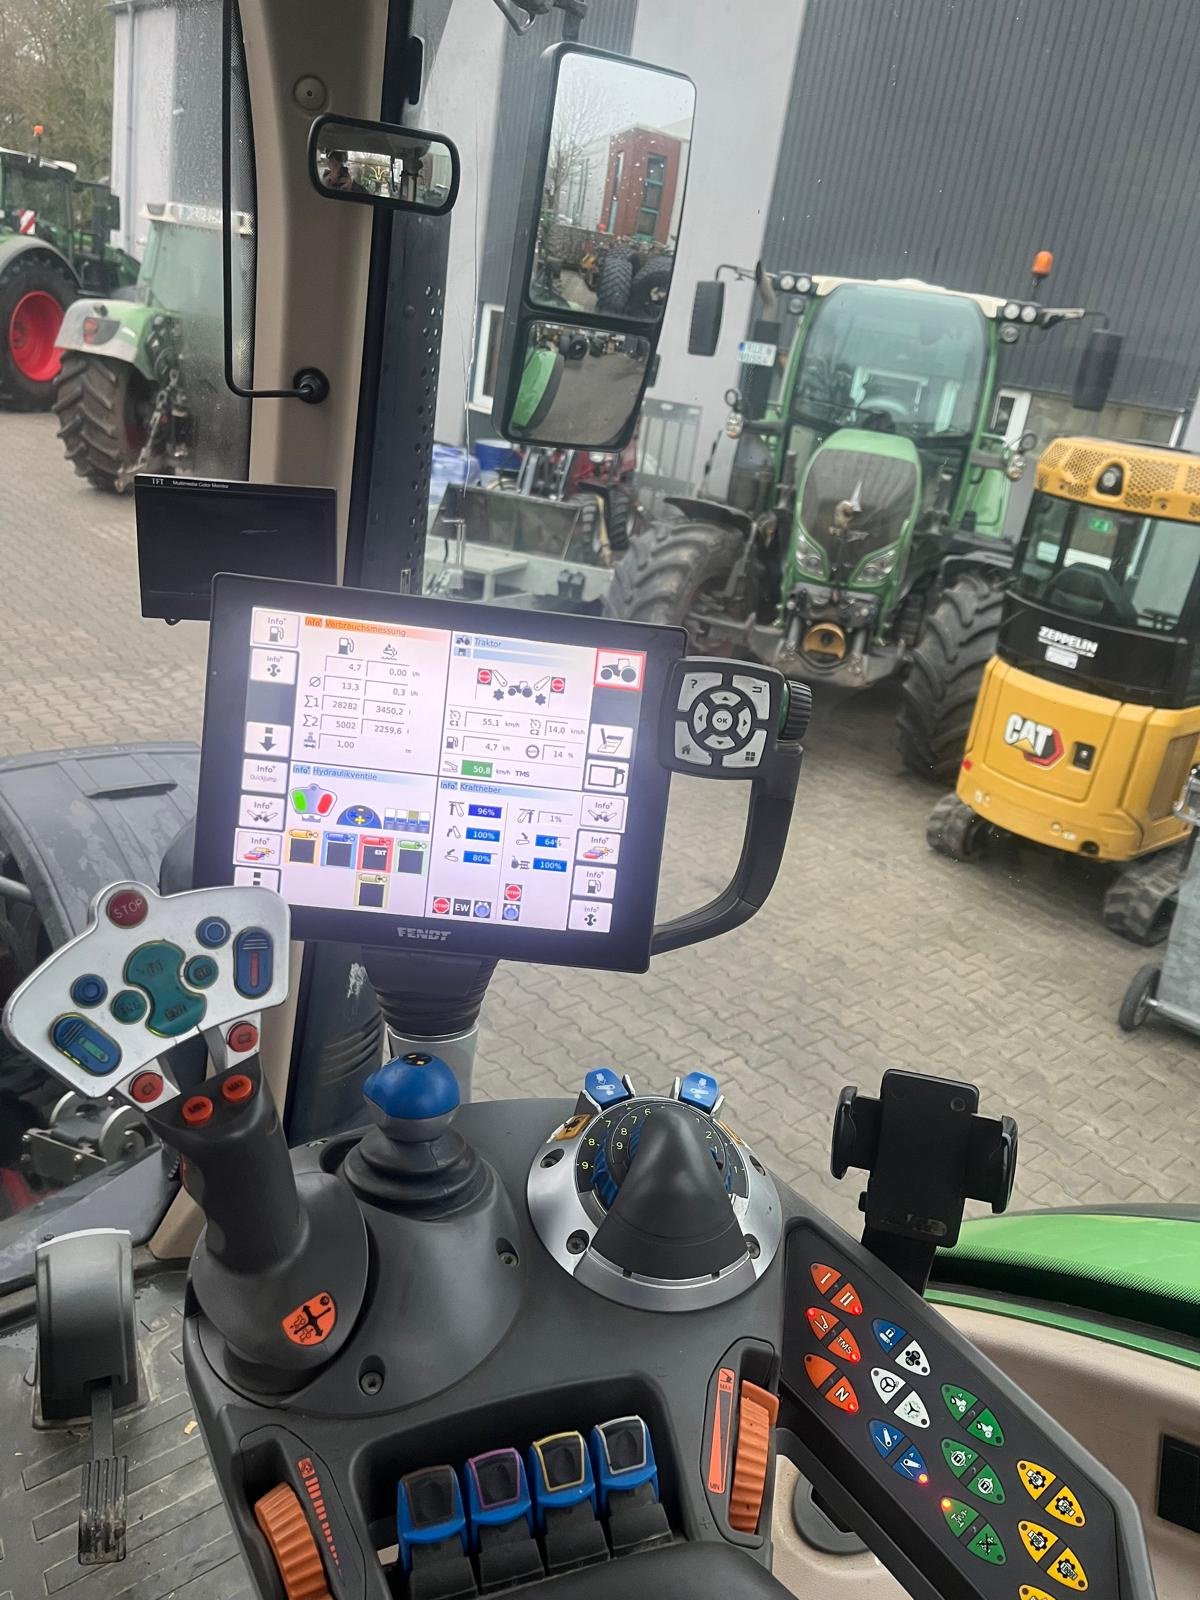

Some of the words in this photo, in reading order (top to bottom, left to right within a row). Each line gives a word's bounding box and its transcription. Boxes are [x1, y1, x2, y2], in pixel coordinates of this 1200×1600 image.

[151, 478, 164, 486] TFT
[325, 619, 406, 637] Verbrauchsmessung
[474, 637, 502, 648] Traktor
[1038, 625, 1098, 653] ZEPPELIN
[389, 668, 408, 678] 0,00
[341, 682, 360, 692] 13,3
[392, 687, 406, 697] 0,3
[332, 701, 358, 711] 28282
[376, 705, 404, 716] 3450,2
[335, 721, 356, 730] 5002
[482, 717, 500, 727] 55,1
[717, 717, 728, 725] OK
[374, 725, 402, 735] 2259,6
[548, 725, 566, 735] 14,0
[1004, 713, 1054, 757] CAT
[336, 740, 355, 749] 1,00
[553, 750, 563, 758] 14
[312, 767, 378, 781] Hydraulikventile
[473, 765, 491, 775] 50,8
[515, 770, 530, 778] TMS
[460, 782, 501, 795] Kraftheber
[477, 807, 495, 816] 96%
[550, 815, 562, 824] 1%
[473, 831, 495, 840] 100%
[544, 837, 562, 847] 64%
[472, 853, 490, 863] 80%
[540, 861, 562, 871] 100%
[113, 899, 143, 919] STOP
[455, 903, 470, 912] EW
[397, 926, 452, 941] FENDT
[605, 1120, 612, 1128] 7
[631, 1116, 638, 1124] 7
[621, 1128, 628, 1136] 8
[705, 1131, 712, 1139] 2
[588, 1138, 596, 1146] 8
[616, 1142, 623, 1150] 9
[581, 1161, 589, 1170] 9
[837, 1336, 853, 1354] TMS
[835, 1387, 850, 1402] N
